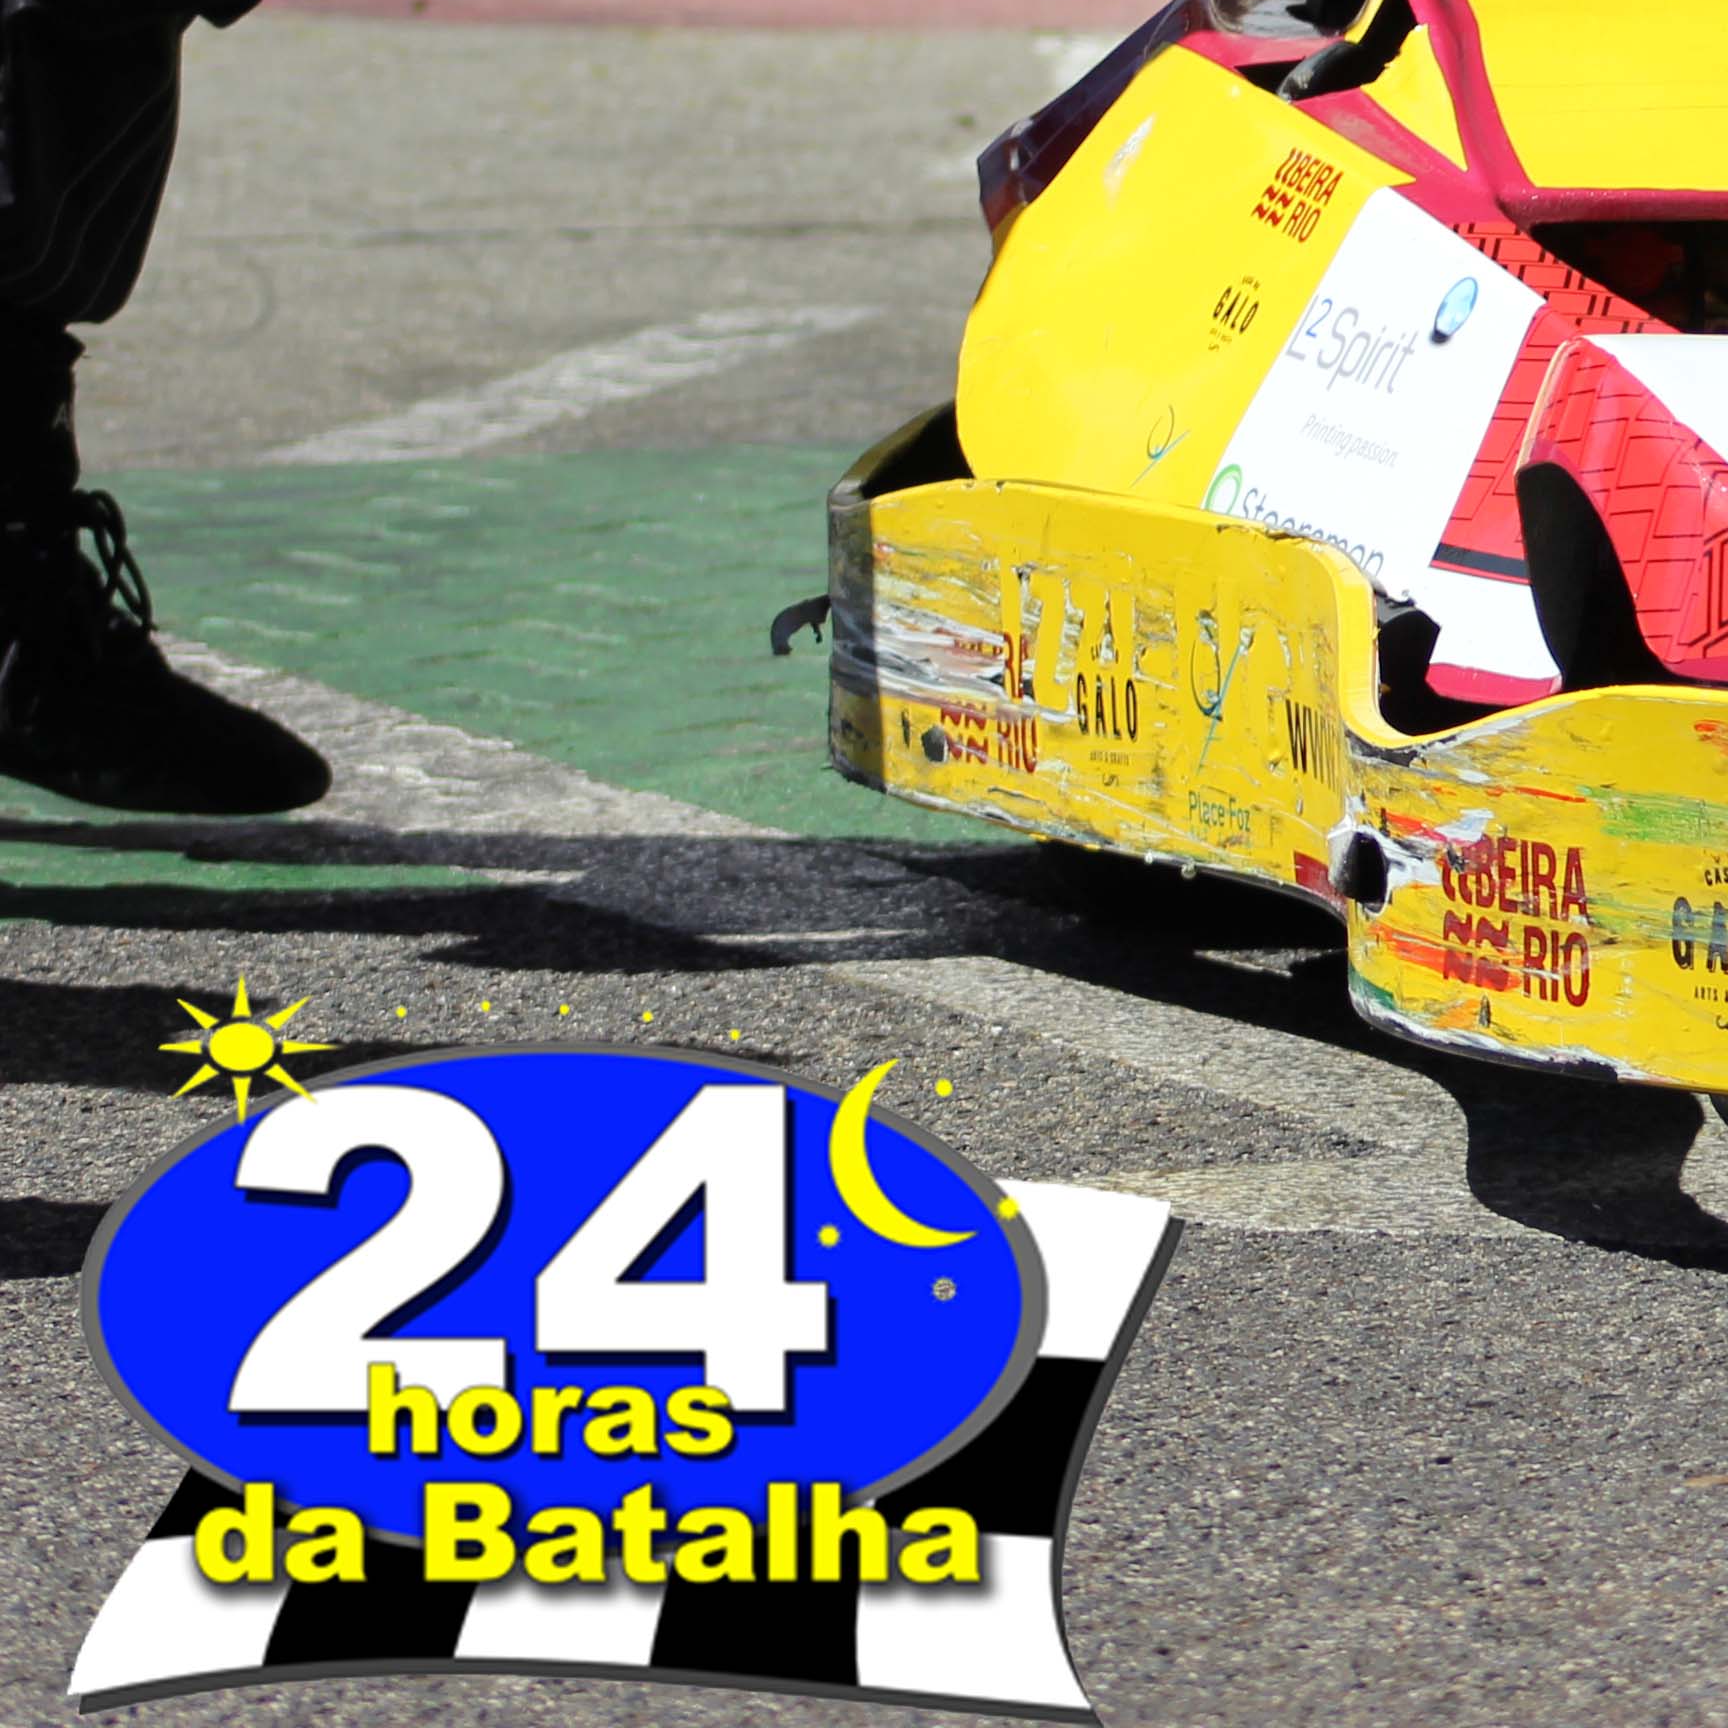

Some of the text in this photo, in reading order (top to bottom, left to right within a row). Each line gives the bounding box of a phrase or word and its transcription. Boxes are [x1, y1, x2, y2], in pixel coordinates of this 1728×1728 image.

[1286, 153, 1344, 207] BEIRA
[1282, 200, 1322, 243] RIO
[1212, 285, 1259, 335] GALO
[1316, 306, 1418, 395] Spirit
[1075, 672, 1139, 744] GALO
[1188, 789, 1251, 833] Place Foz
[1522, 924, 1590, 1008] RIO
[1693, 985, 1719, 1002] ARTS
